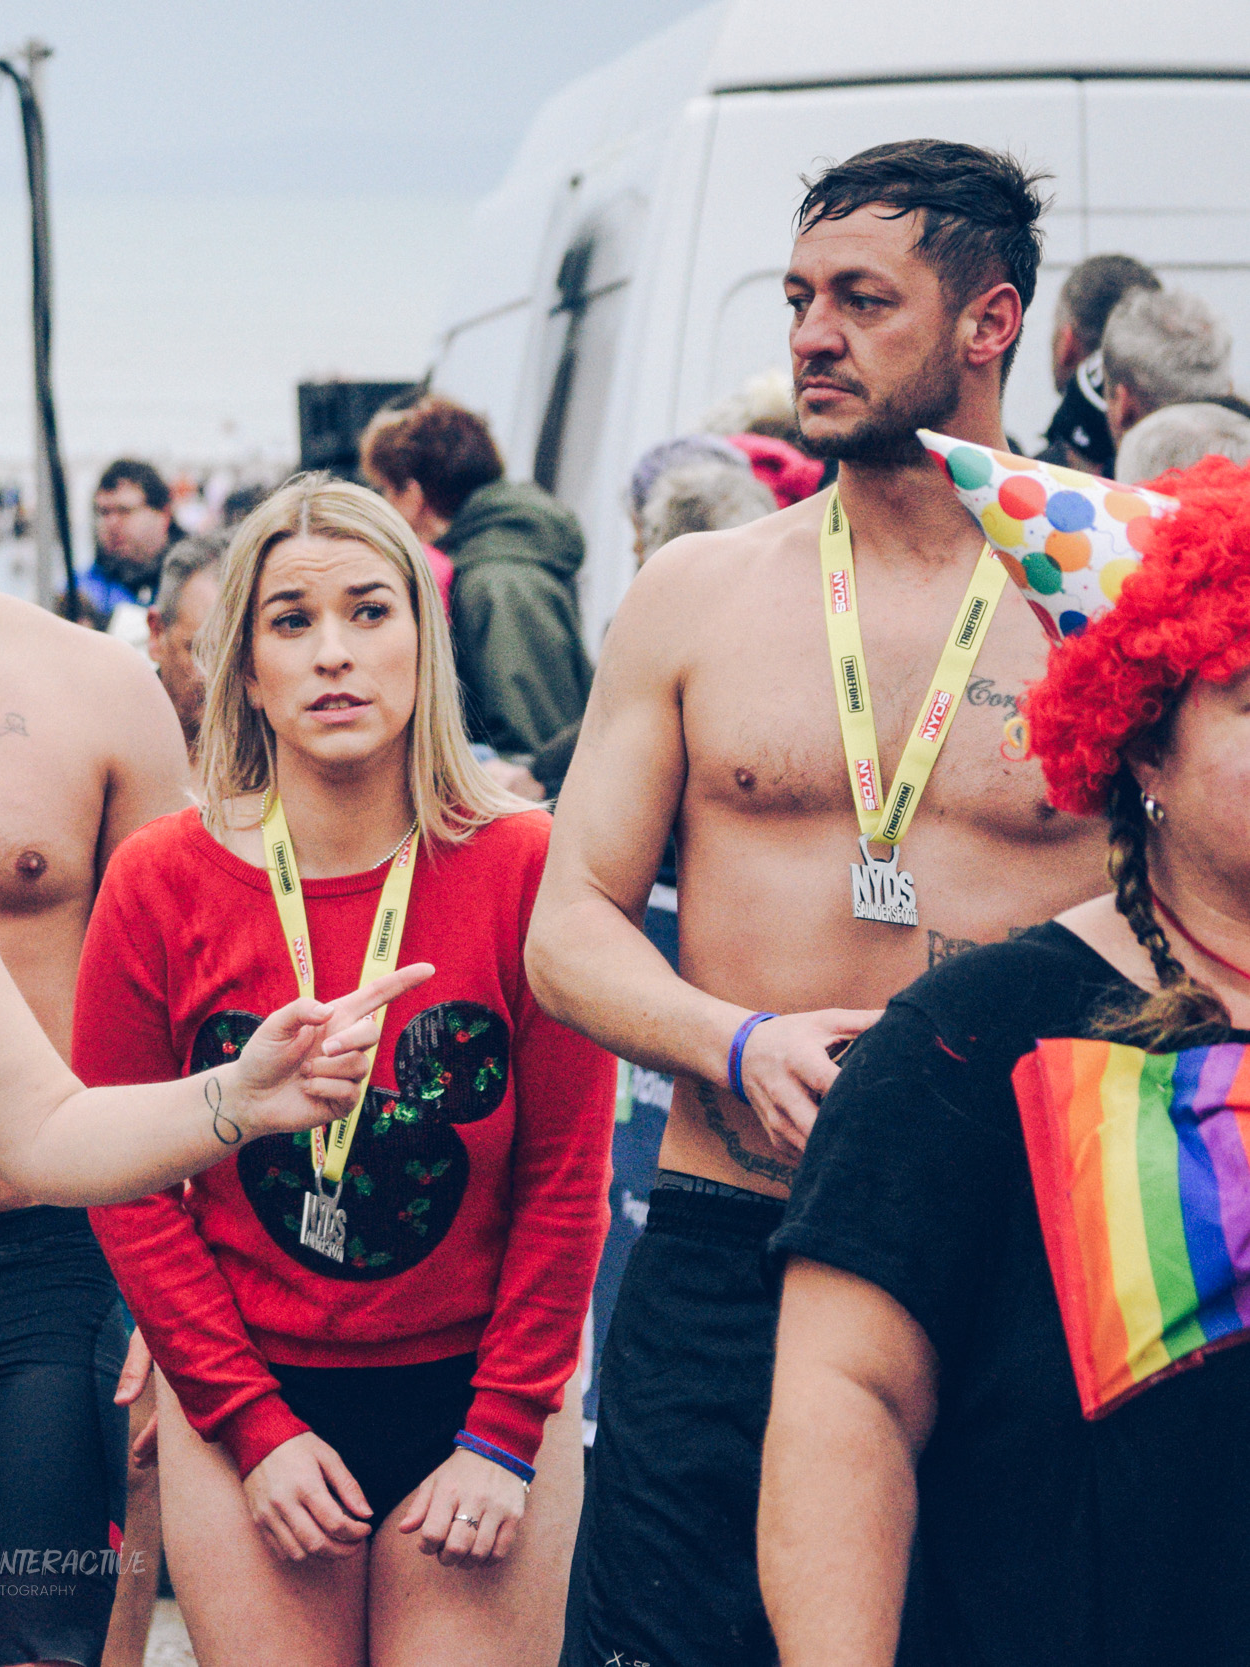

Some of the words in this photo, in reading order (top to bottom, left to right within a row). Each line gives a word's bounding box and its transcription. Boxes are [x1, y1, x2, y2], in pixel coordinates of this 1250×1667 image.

[832, 571, 846, 613] NYDS
[959, 599, 984, 645] TRUEFORM
[844, 659, 861, 711] TRUEFORM
[922, 691, 951, 742] NYDS
[858, 759, 876, 811] NYDS
[887, 785, 911, 838] TRUEFORM
[275, 844, 292, 893] TRUEFORM
[850, 863, 917, 909] NYDS
[376, 911, 393, 958] TRUEFORM
[294, 936, 310, 985] NYDS
